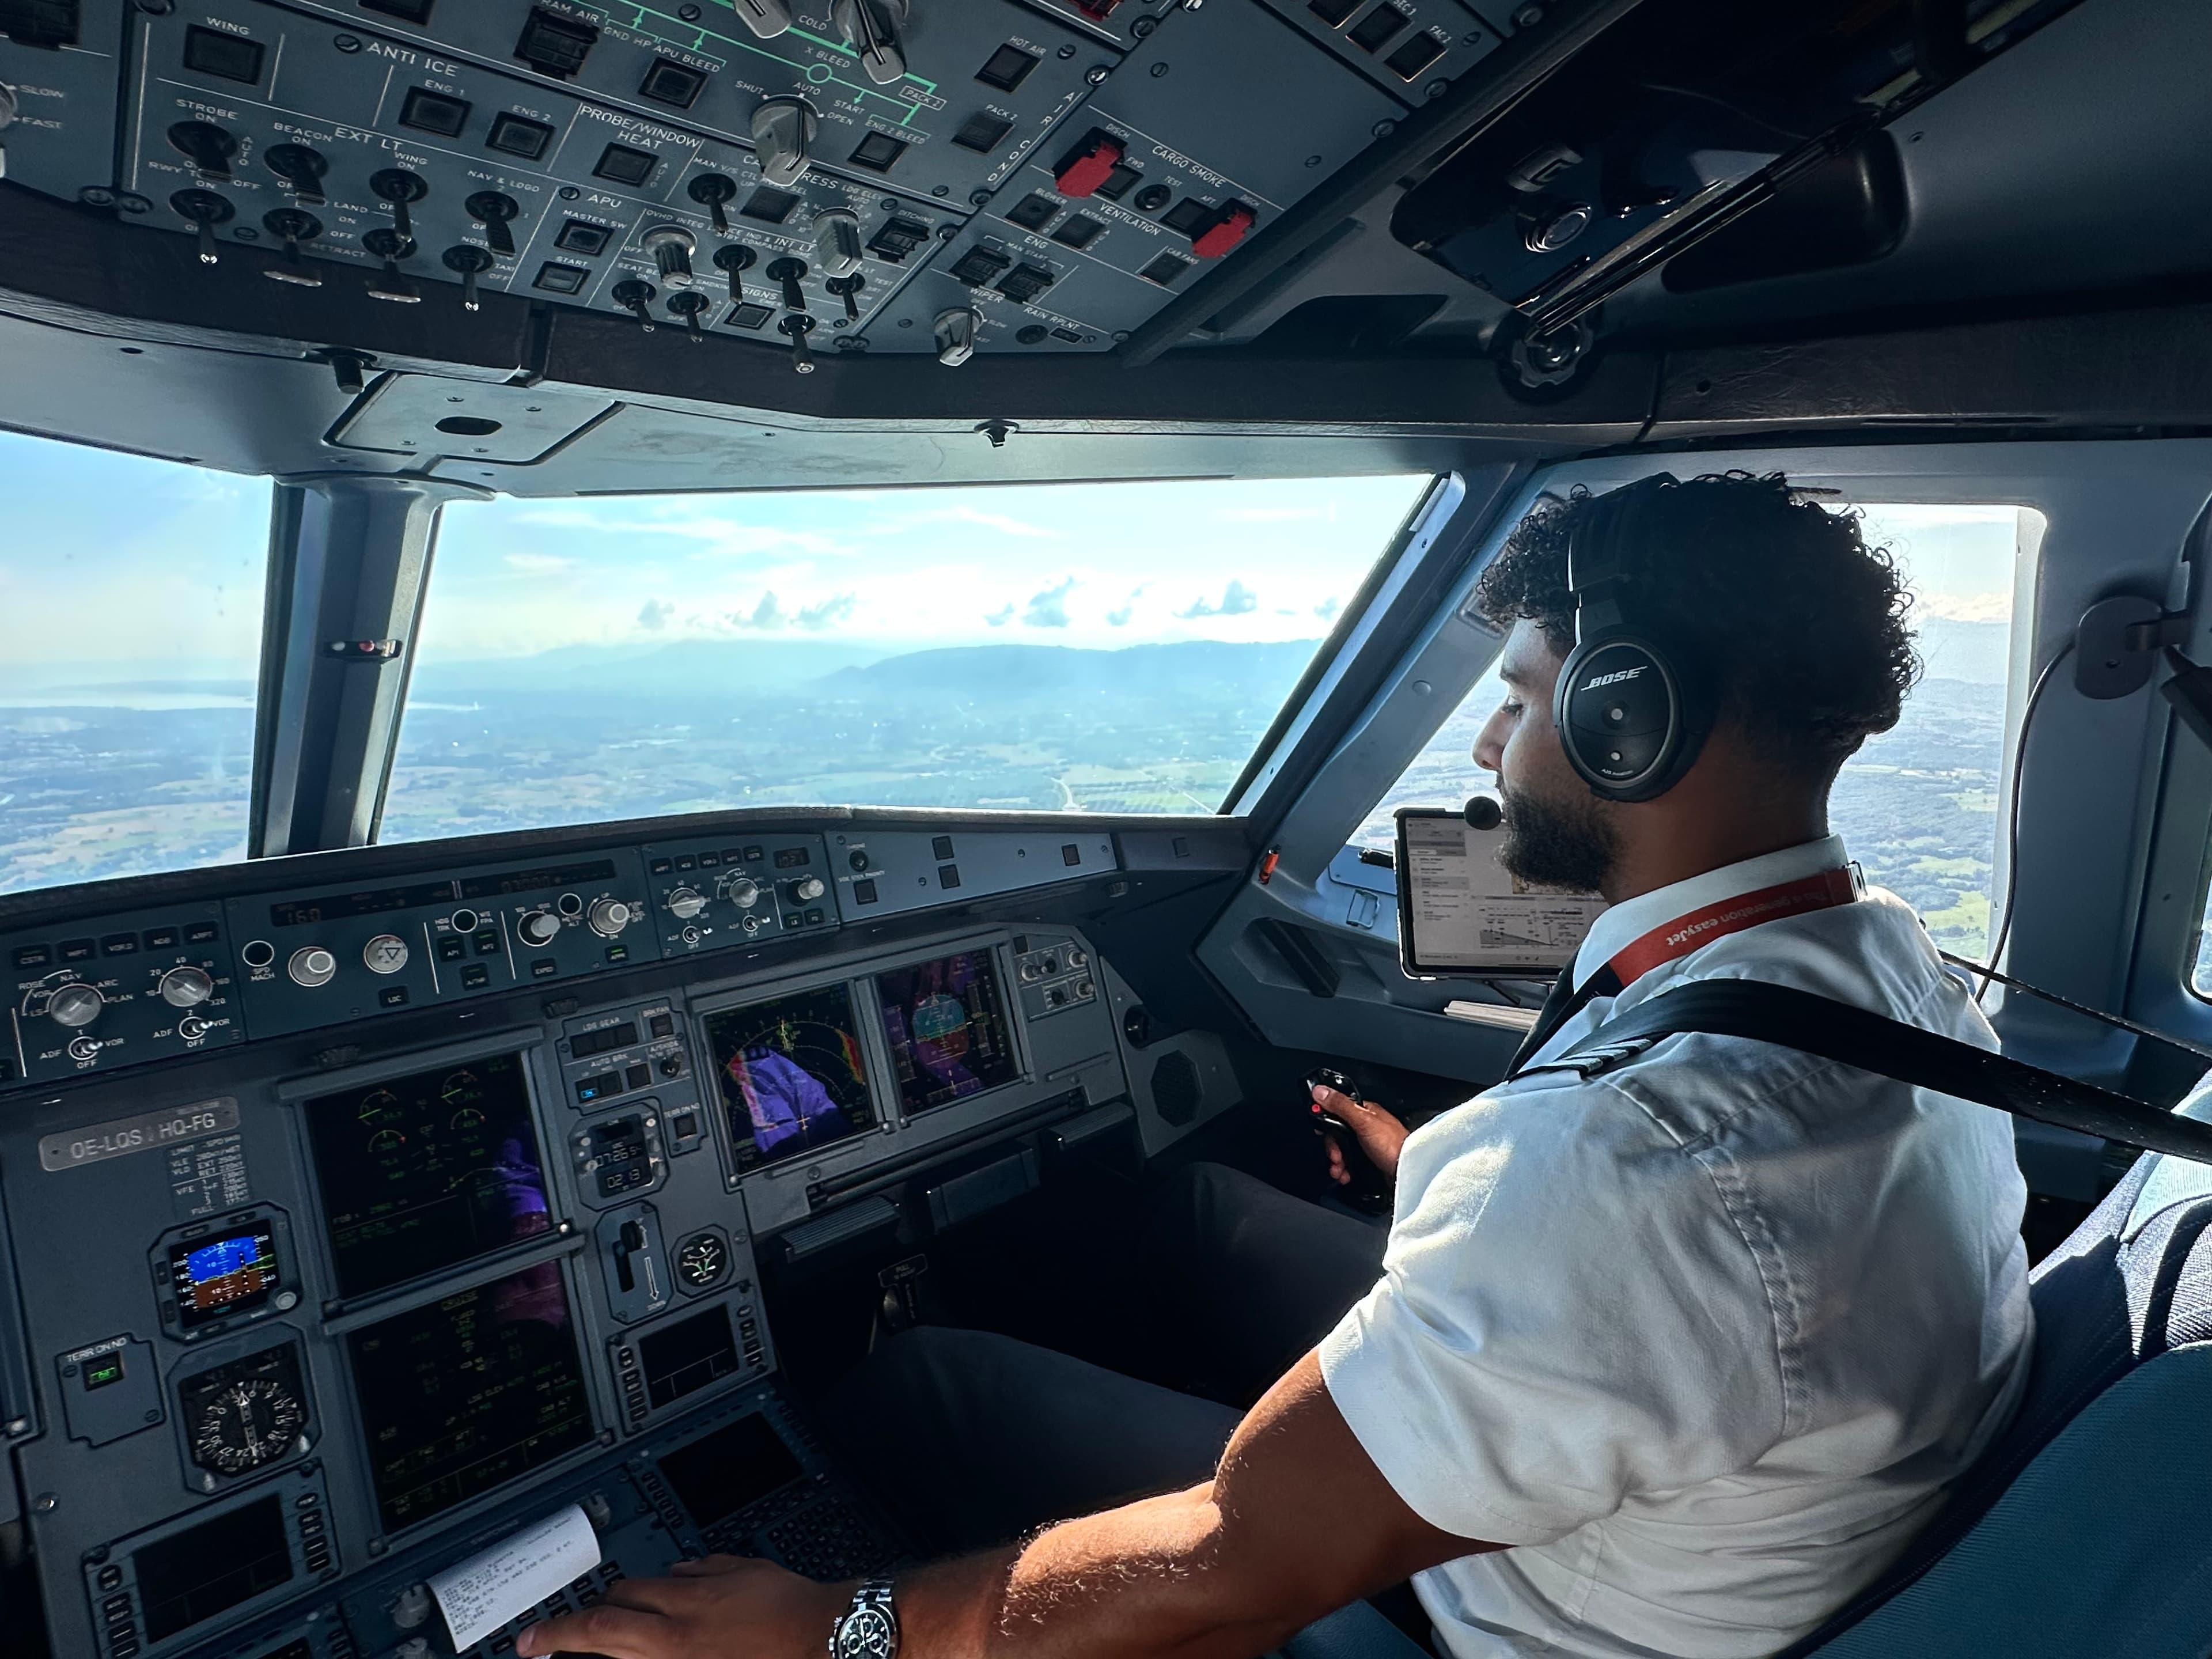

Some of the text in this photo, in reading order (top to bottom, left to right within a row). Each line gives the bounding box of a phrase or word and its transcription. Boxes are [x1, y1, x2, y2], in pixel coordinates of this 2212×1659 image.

[575, 10, 600, 23] AIR
[798, 15, 828, 31] COLD
[206, 16, 250, 36] WING
[603, 26, 652, 47] GND HP
[1009, 35, 1047, 56] HOT AIR
[367, 41, 460, 77] ANTI ICE
[653, 45, 721, 73] APU BLEED
[804, 46, 851, 69] X BLEED
[20, 84, 65, 98] SLOW
[425, 79, 453, 94] ENG
[734, 79, 764, 95] SHUT
[791, 81, 821, 96] AUTO
[904, 89, 931, 104] PACK
[176, 99, 238, 120] STROBE
[512, 104, 552, 122] ENG 2
[833, 100, 866, 115] START
[985, 103, 1010, 118] PACK
[22, 117, 63, 128] FAST
[195, 112, 216, 123] ON
[826, 111, 854, 127] OPEN
[274, 122, 333, 143] BEACON
[580, 104, 702, 149] PROBE/WINDOW
[865, 119, 885, 131] ENG
[895, 129, 926, 145] BLEED
[1105, 123, 1131, 139] DISCH
[291, 136, 311, 146] ON
[335, 127, 403, 151] EXT LT
[618, 130, 662, 150] HEAT
[238, 136, 253, 166] AUTO
[394, 151, 429, 165] WING
[149, 161, 183, 173] RWY
[397, 161, 416, 171] ON
[692, 157, 715, 168] MAN
[1125, 156, 1145, 169] FWD
[1152, 145, 1227, 188] CARGO SMOKE
[195, 180, 217, 190] ON
[233, 179, 263, 190] OFF
[467, 169, 493, 181] NAV
[509, 180, 540, 193] LOGO
[800, 172, 839, 189] RESS
[1164, 175, 1183, 188] TEST
[587, 194, 622, 209] APU
[1035, 187, 1069, 205] BLOWER
[334, 201, 369, 213] LAND
[338, 215, 357, 225] ON
[563, 209, 628, 229] MASTER SW
[1080, 207, 1113, 225] EXTRACT
[1100, 203, 1162, 237] VENTILATION
[329, 230, 355, 240] OFF
[1024, 234, 1049, 249] ENG
[774, 237, 815, 252] INT LT
[554, 255, 589, 267] START
[741, 286, 779, 301] SIGNS
[969, 287, 1004, 303] WIPER
[1022, 306, 1081, 331] RAIN RPLNT
[1580, 665, 1648, 691] BOSE
[1720, 897, 1791, 923] generation
[1665, 917, 1719, 946] easyJet
[18, 979, 46, 991] ROSE
[59, 972, 83, 983] NAV
[97, 979, 119, 989] ARC
[152, 1028, 174, 1039] ADF
[104, 1037, 125, 1047] VOR
[187, 1038, 206, 1048] OFF
[39, 1048, 63, 1060] ADF
[76, 1058, 98, 1069] OFF
[158, 1112, 215, 1139] HQ-FG
